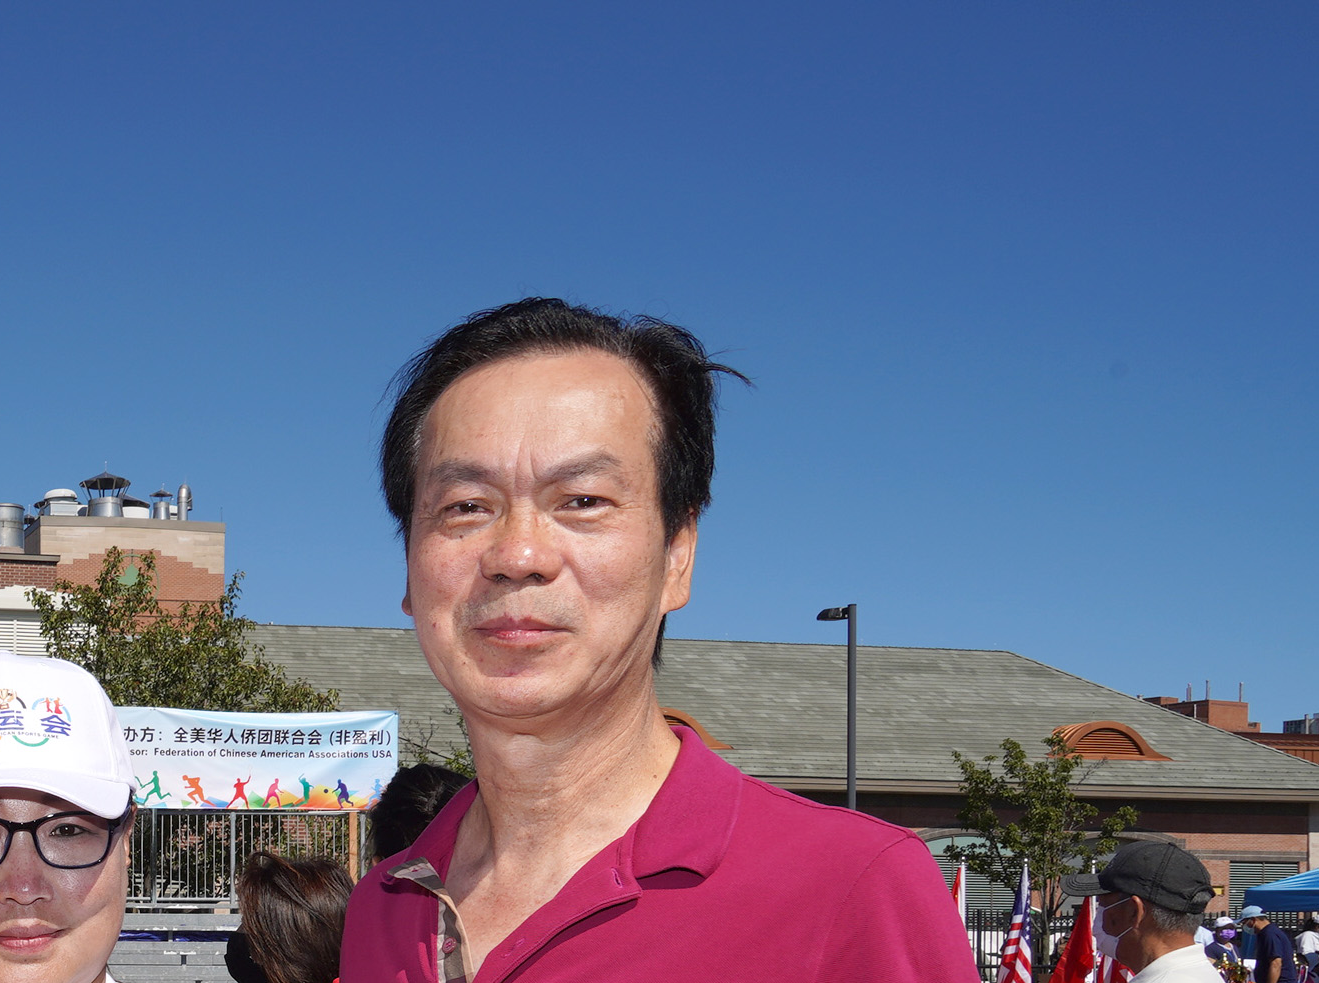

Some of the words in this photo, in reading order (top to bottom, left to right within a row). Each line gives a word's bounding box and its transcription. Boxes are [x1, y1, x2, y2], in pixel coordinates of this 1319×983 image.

[154, 747, 205, 757] Federation
[207, 748, 217, 757] of
[219, 748, 257, 758] Chinese
[260, 749, 306, 759] American
[308, 750, 369, 759] Associations
[372, 750, 393, 759] USA
